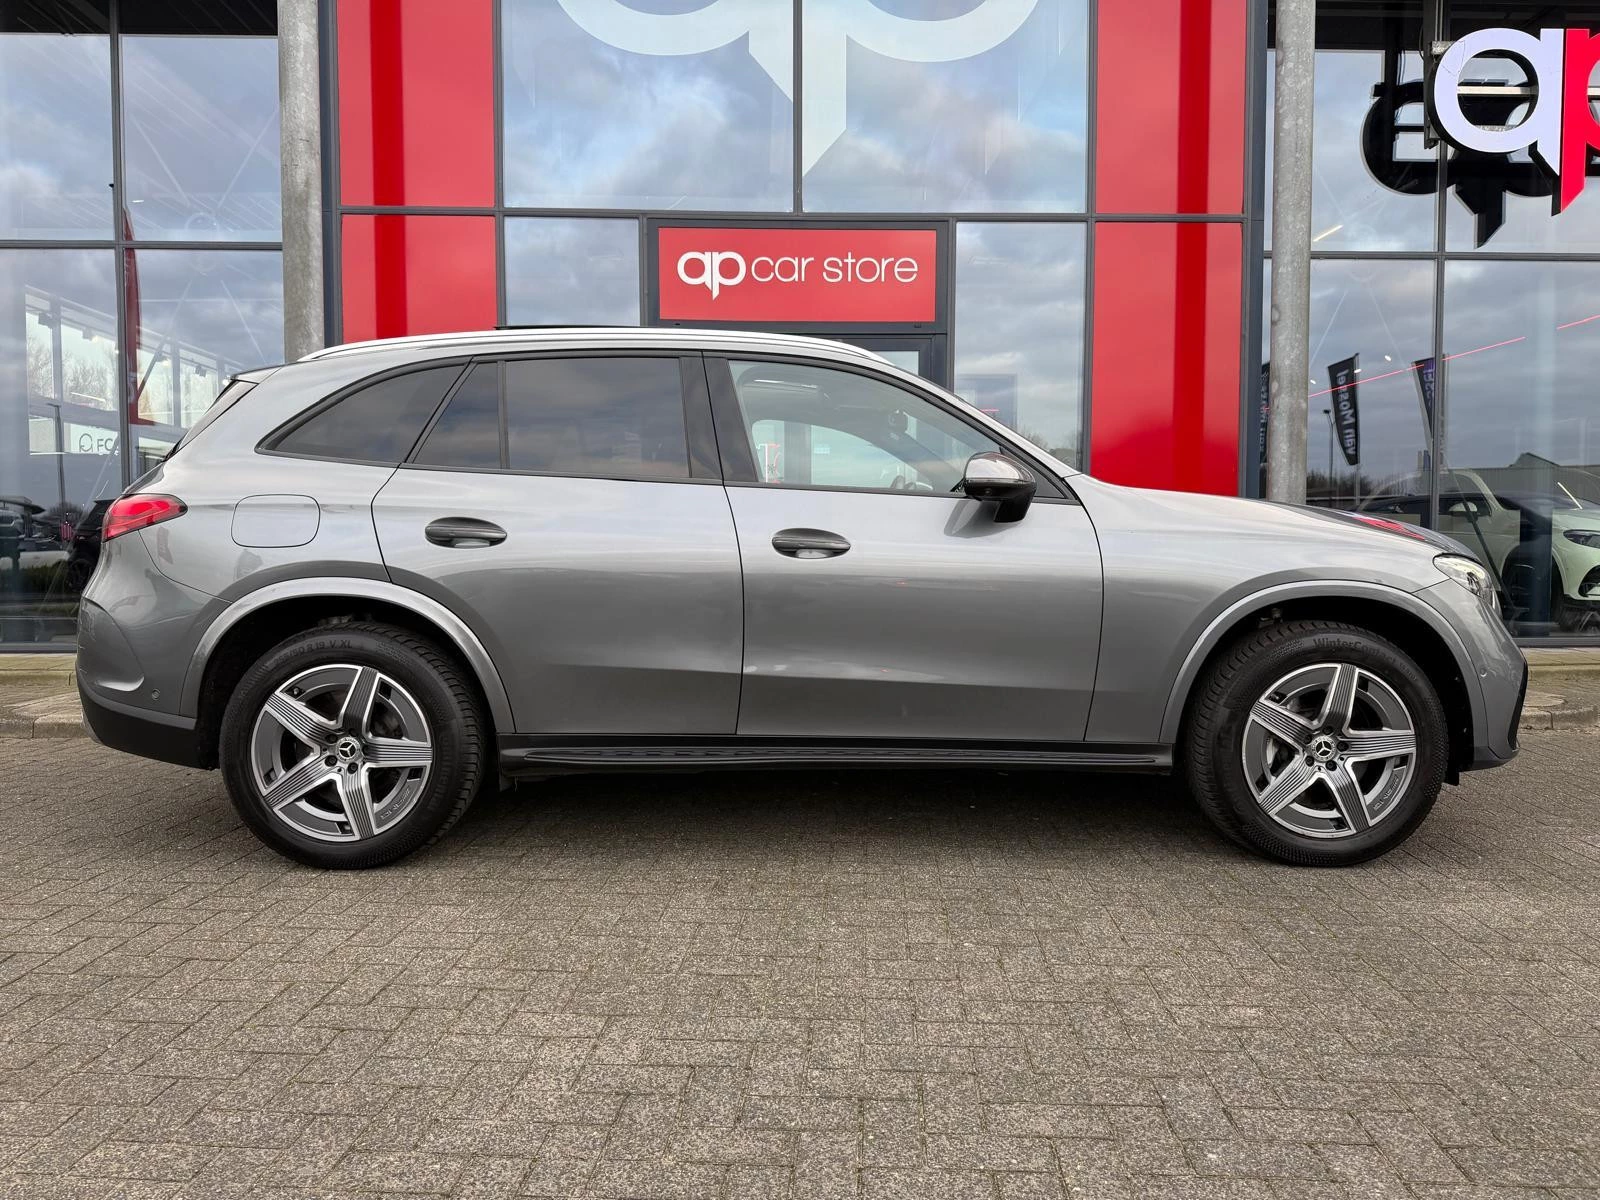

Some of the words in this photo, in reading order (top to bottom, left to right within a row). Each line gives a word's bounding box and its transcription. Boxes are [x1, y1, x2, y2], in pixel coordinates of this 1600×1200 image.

[677, 251, 747, 301] ap
[751, 256, 815, 282] car
[823, 251, 918, 283] store
